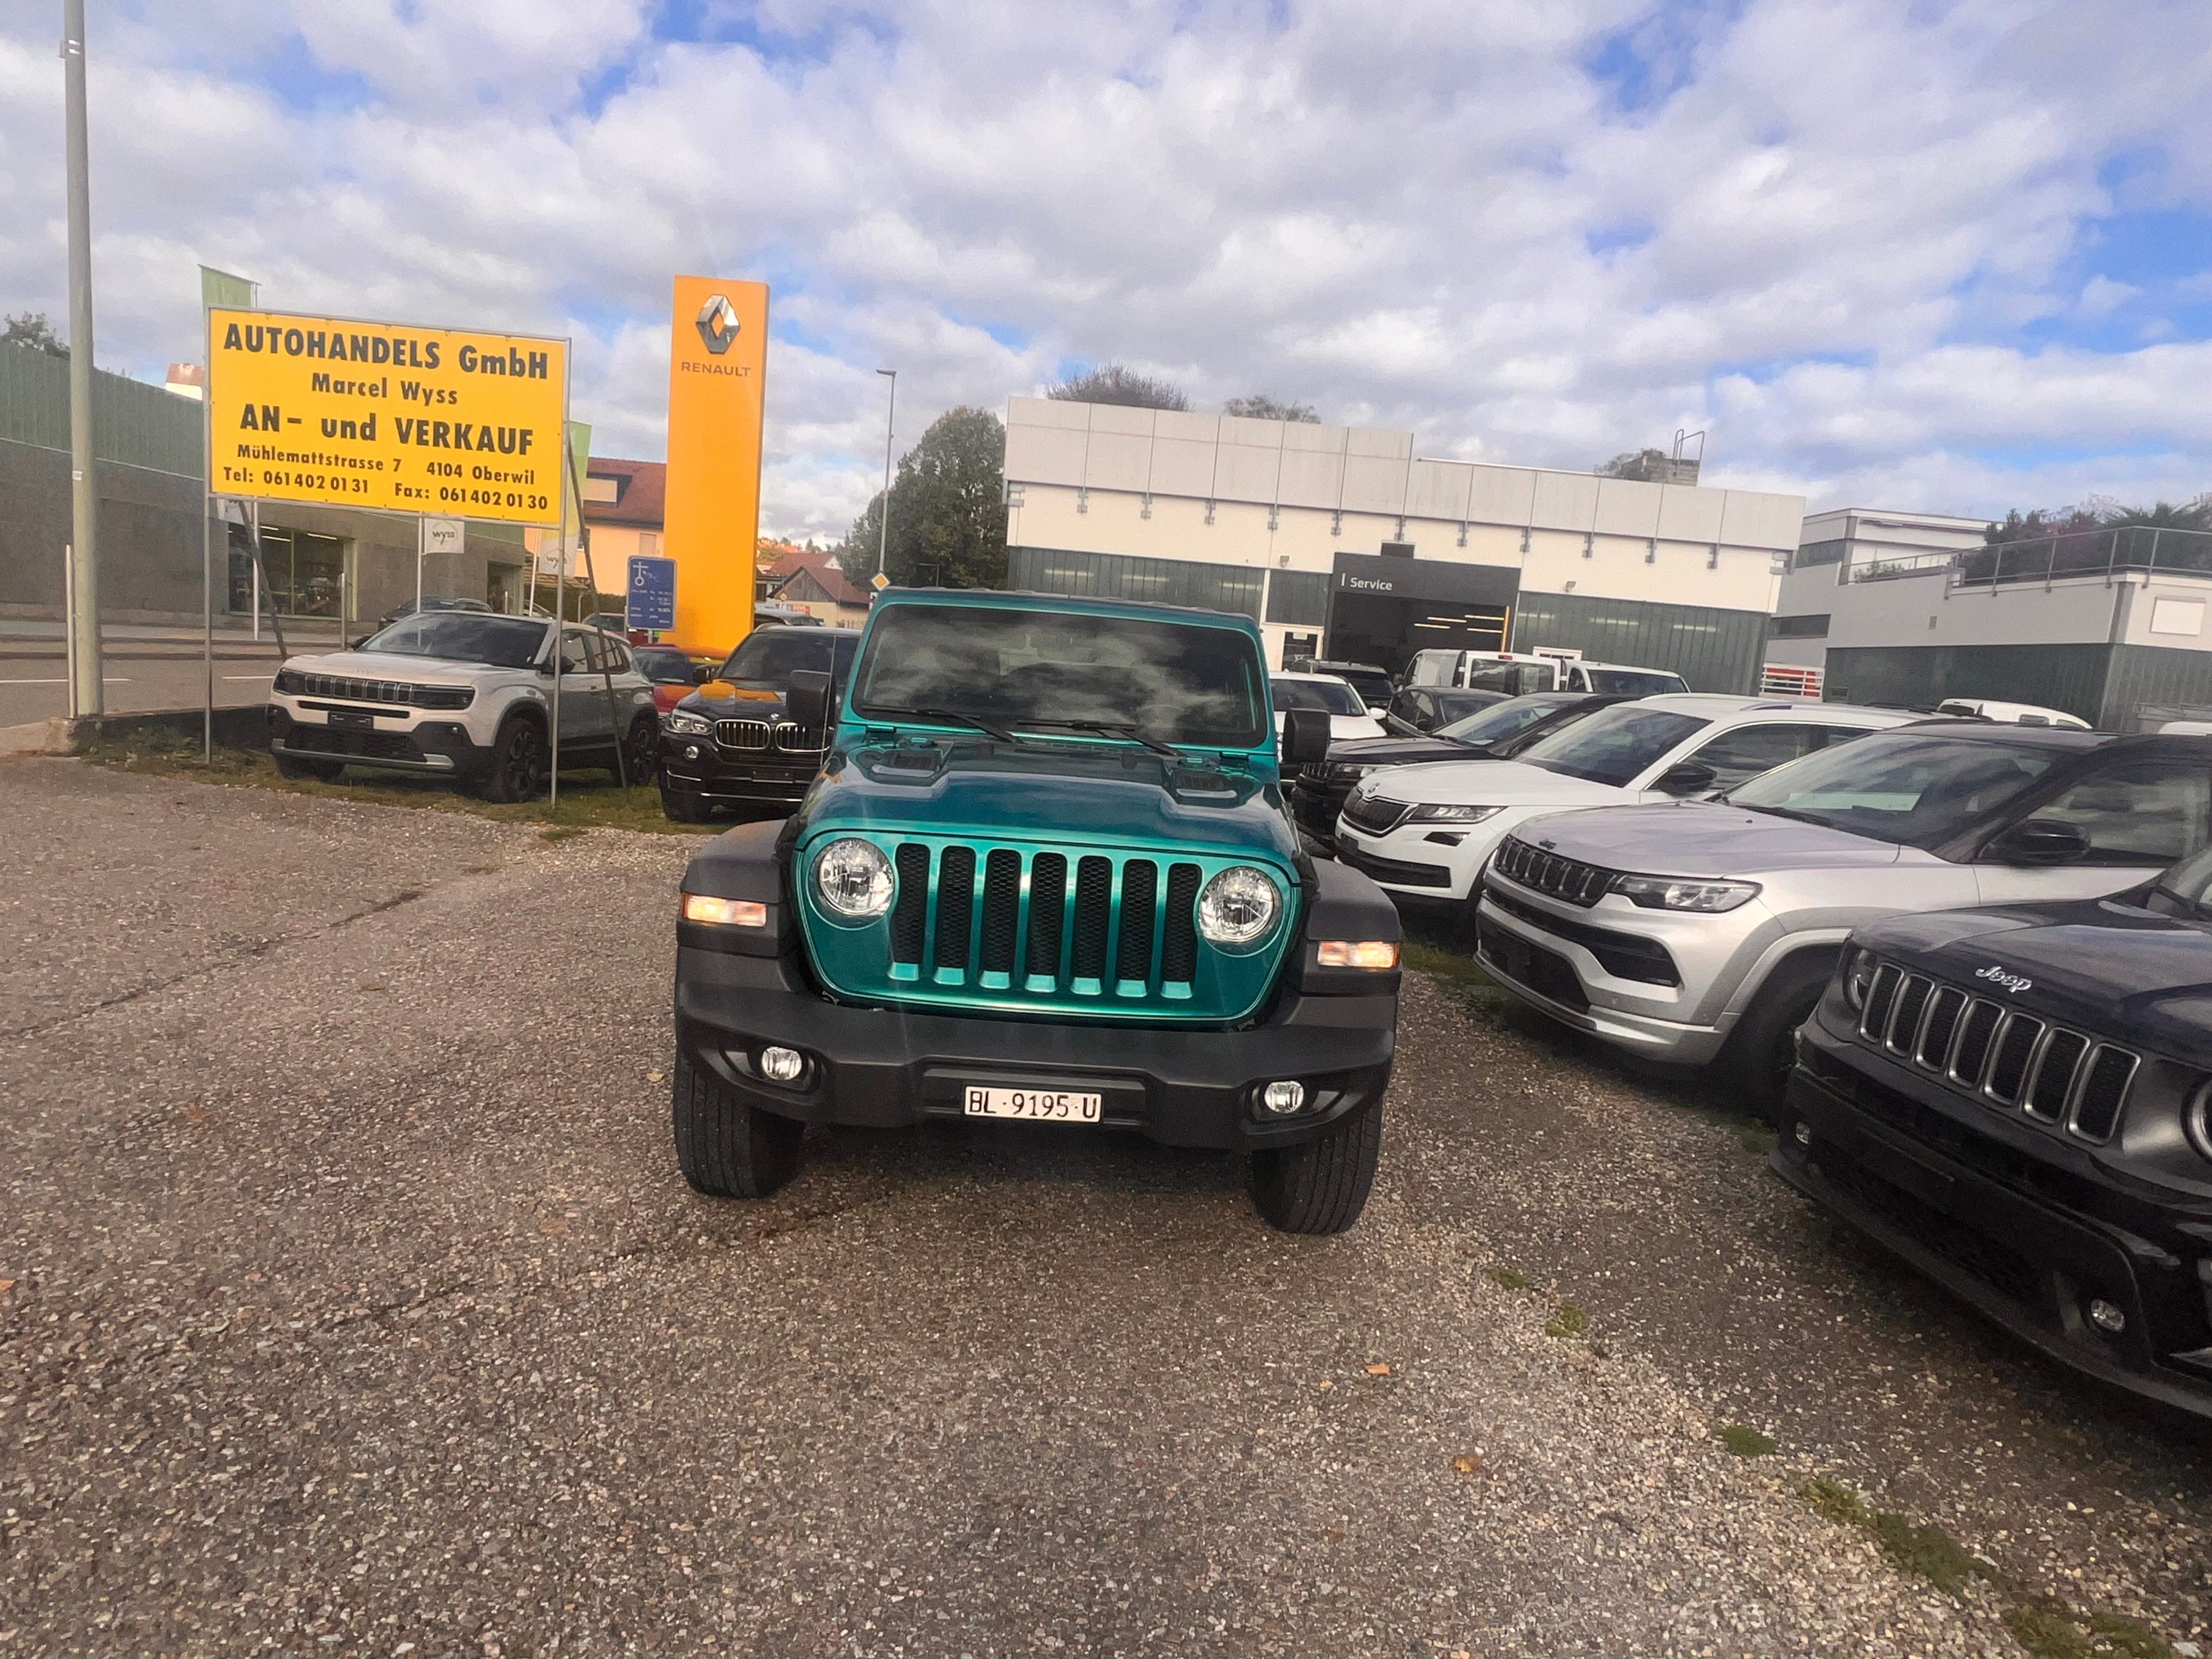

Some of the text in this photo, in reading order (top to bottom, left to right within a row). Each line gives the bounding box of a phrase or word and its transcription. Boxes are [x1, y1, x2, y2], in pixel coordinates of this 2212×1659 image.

[224, 323, 547, 379] AUTOHANDELS GmbH
[681, 362, 751, 377] RENAULT
[312, 372, 458, 407] Marcel Wyss
[321, 412, 376, 442] und
[394, 417, 533, 455] VERKAUF
[238, 444, 534, 485] Mühlemattstrasse 7 4104 Oberwil
[223, 466, 253, 483] Tel:
[395, 482, 430, 499] Fax:
[1350, 577, 1393, 591] Service
[1975, 966, 2032, 993] Jeep
